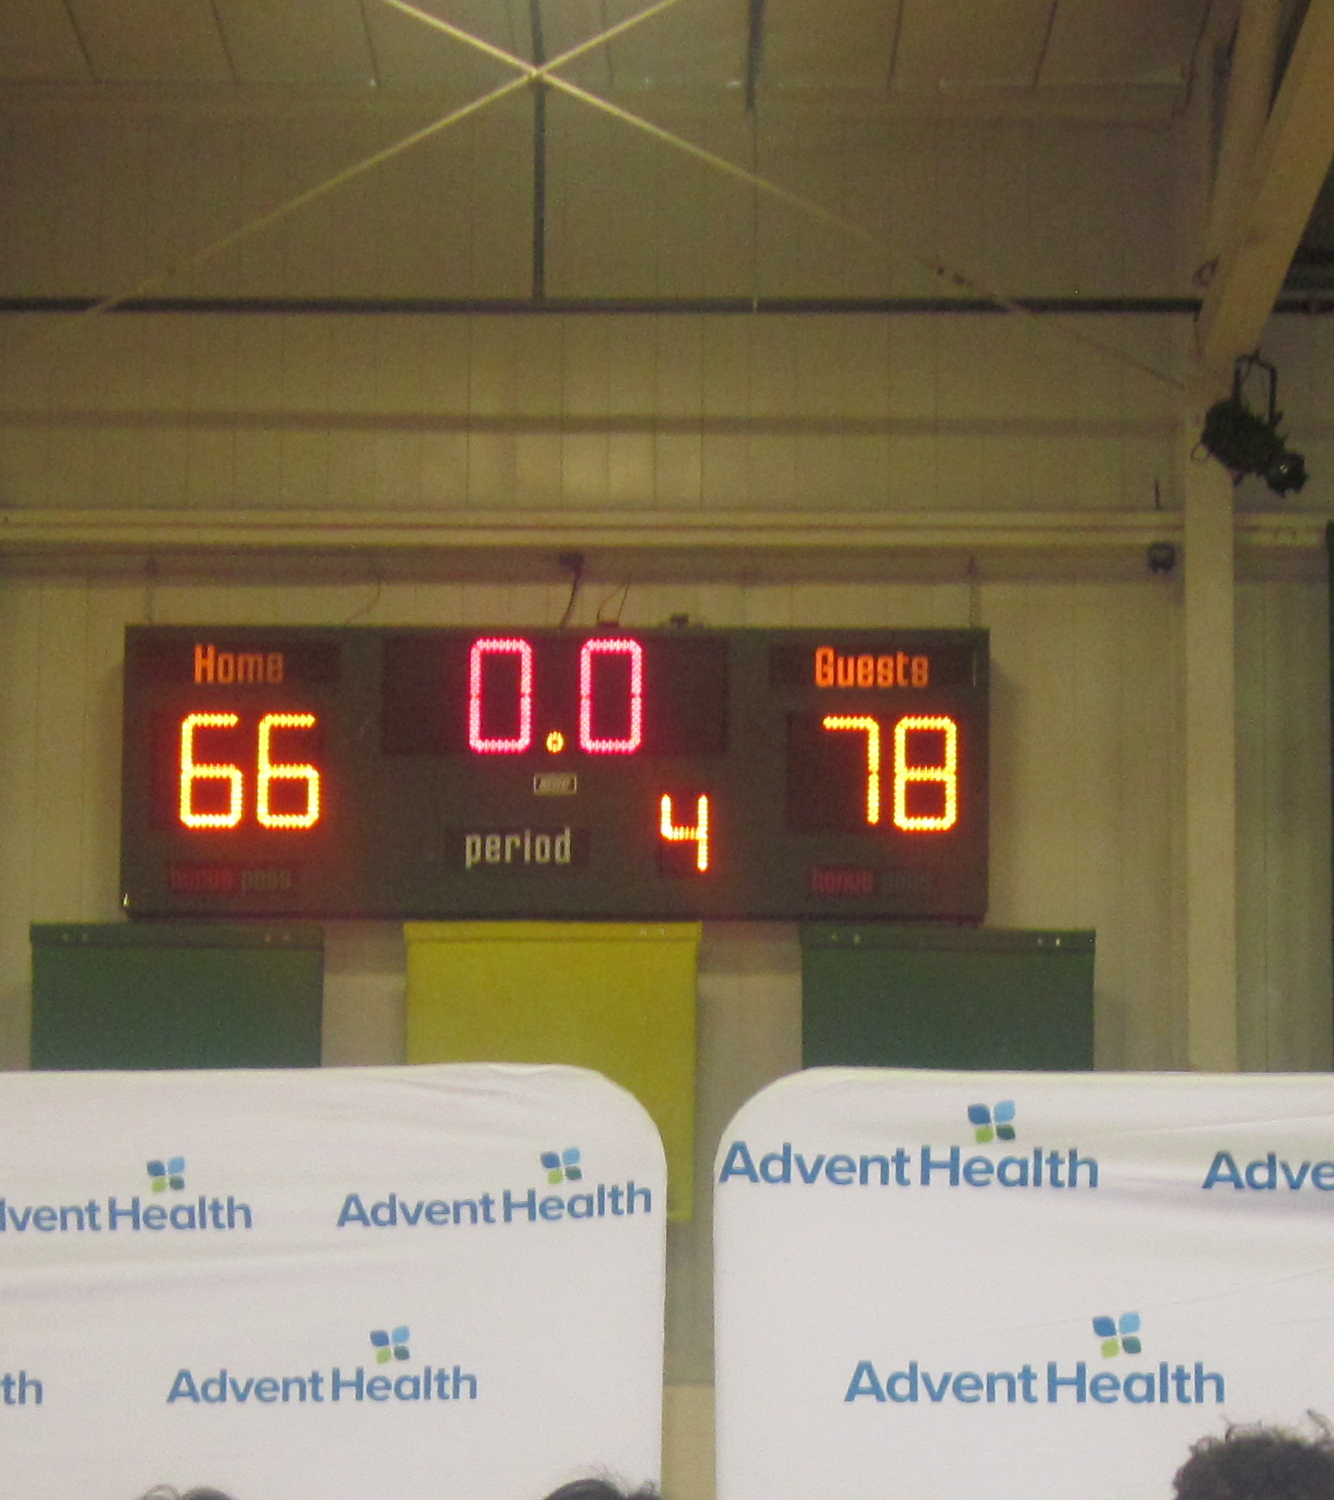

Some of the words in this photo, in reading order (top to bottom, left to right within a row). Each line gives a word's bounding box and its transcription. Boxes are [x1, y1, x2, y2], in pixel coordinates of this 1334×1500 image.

[194, 644, 284, 684] Home
[815, 646, 929, 687] Guests
[468, 638, 643, 754] 0.0
[180, 713, 320, 829] 66
[822, 714, 957, 831] 78
[466, 827, 571, 869] period
[660, 793, 708, 872] 4
[718, 1141, 1099, 1191] AdventHealth
[335, 1181, 652, 1225] AdventHealth
[165, 1364, 480, 1406] AdventHealth
[842, 1359, 1227, 1405] AdventHealth
